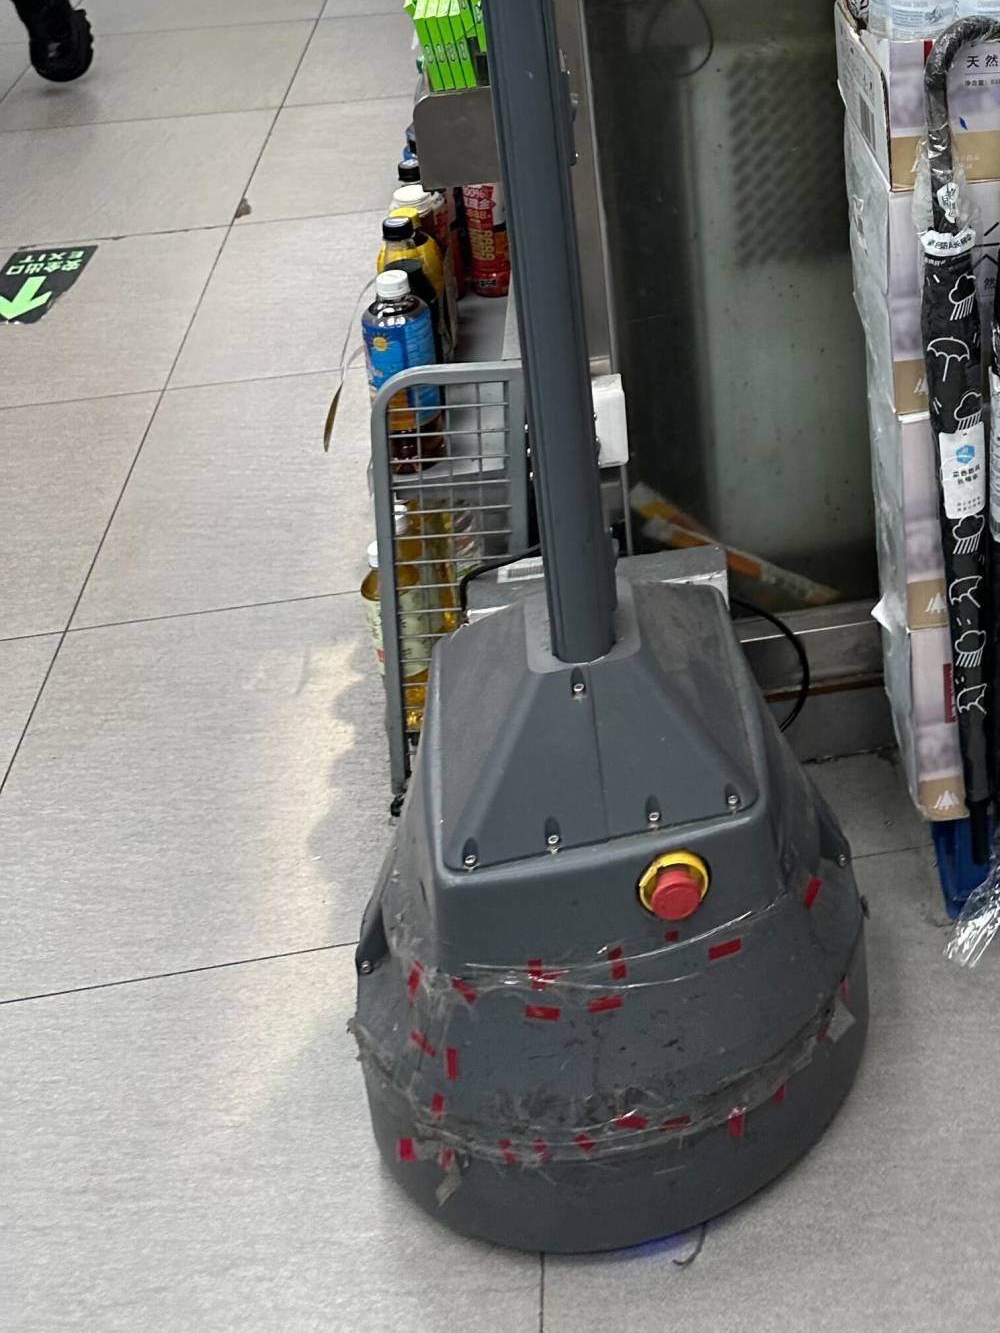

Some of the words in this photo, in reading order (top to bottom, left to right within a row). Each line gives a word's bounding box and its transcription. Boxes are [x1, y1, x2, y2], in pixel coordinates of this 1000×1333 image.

[18, 250, 85, 264] EXIT
[6, 258, 83, 276] 安全出口
